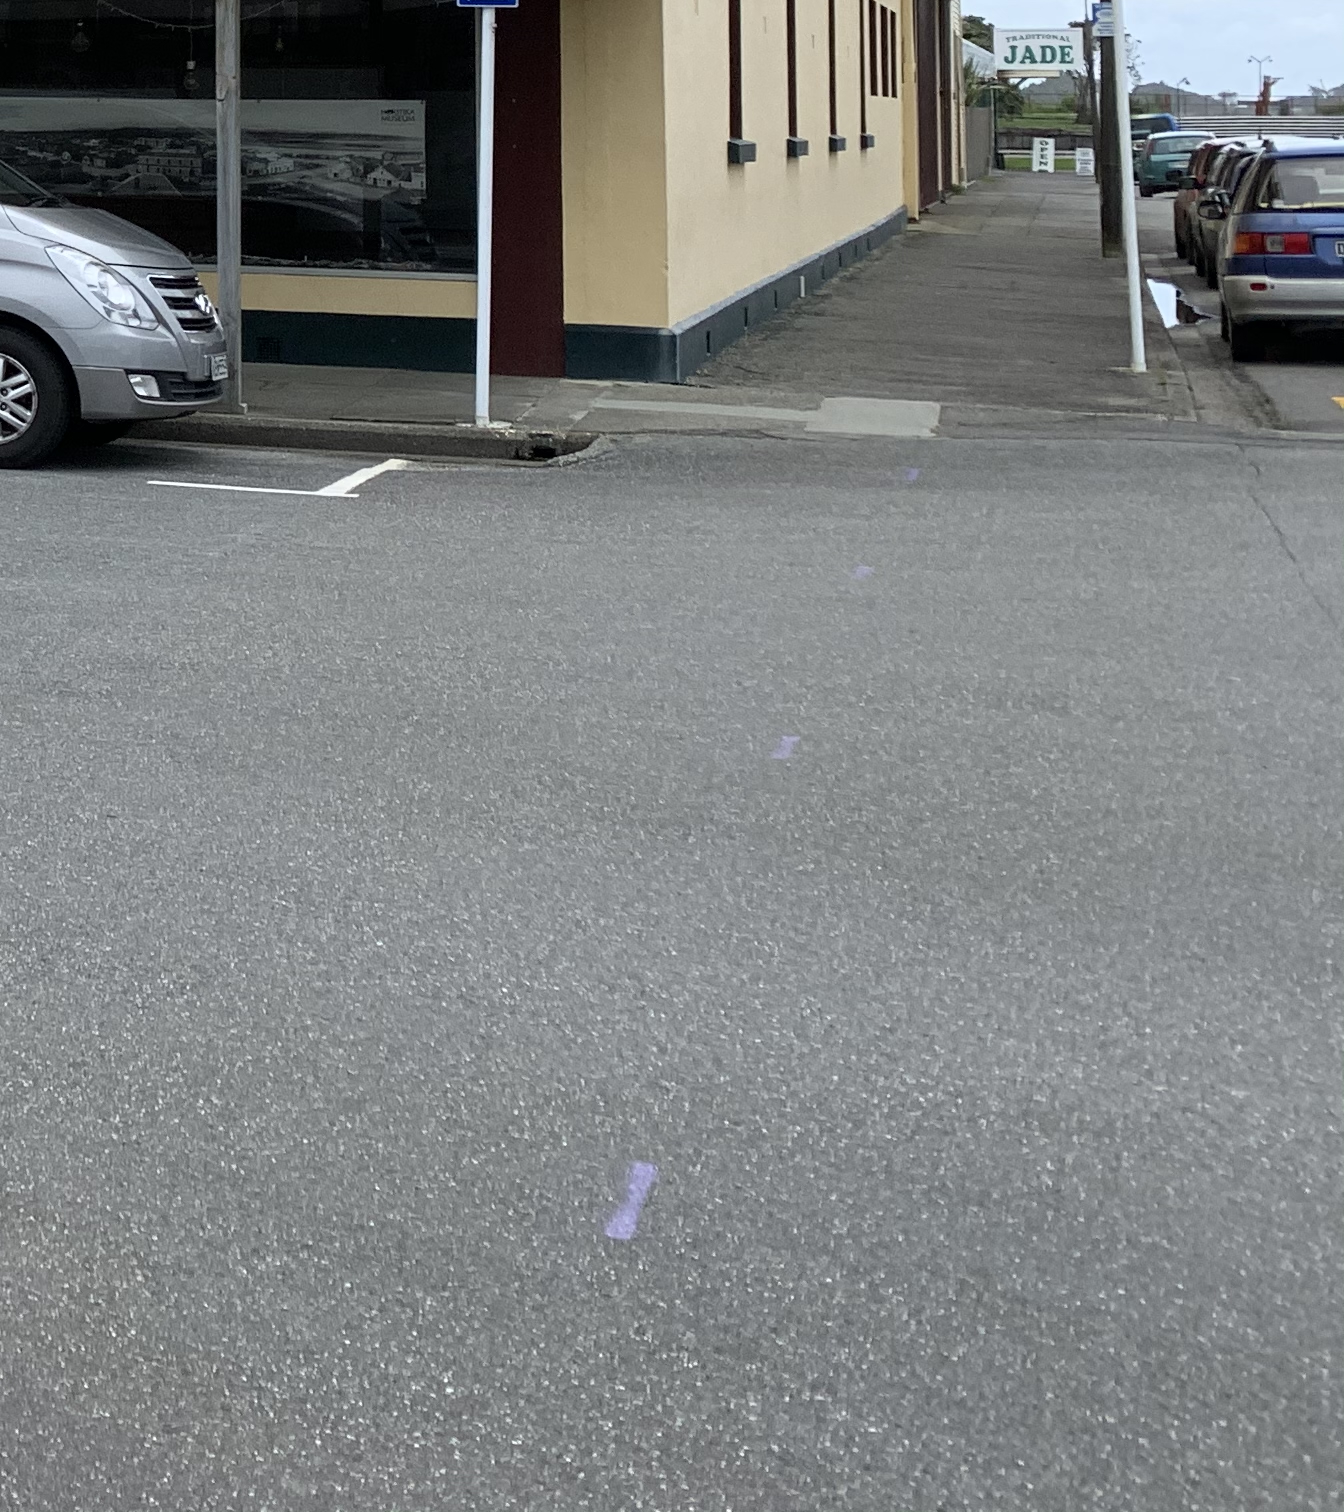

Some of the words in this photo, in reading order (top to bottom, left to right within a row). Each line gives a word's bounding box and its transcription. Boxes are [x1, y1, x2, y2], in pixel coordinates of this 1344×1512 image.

[1005, 33, 1071, 43] TRADITIONAL
[1003, 44, 1075, 65] JADE
[1039, 139, 1050, 167] OPEN
